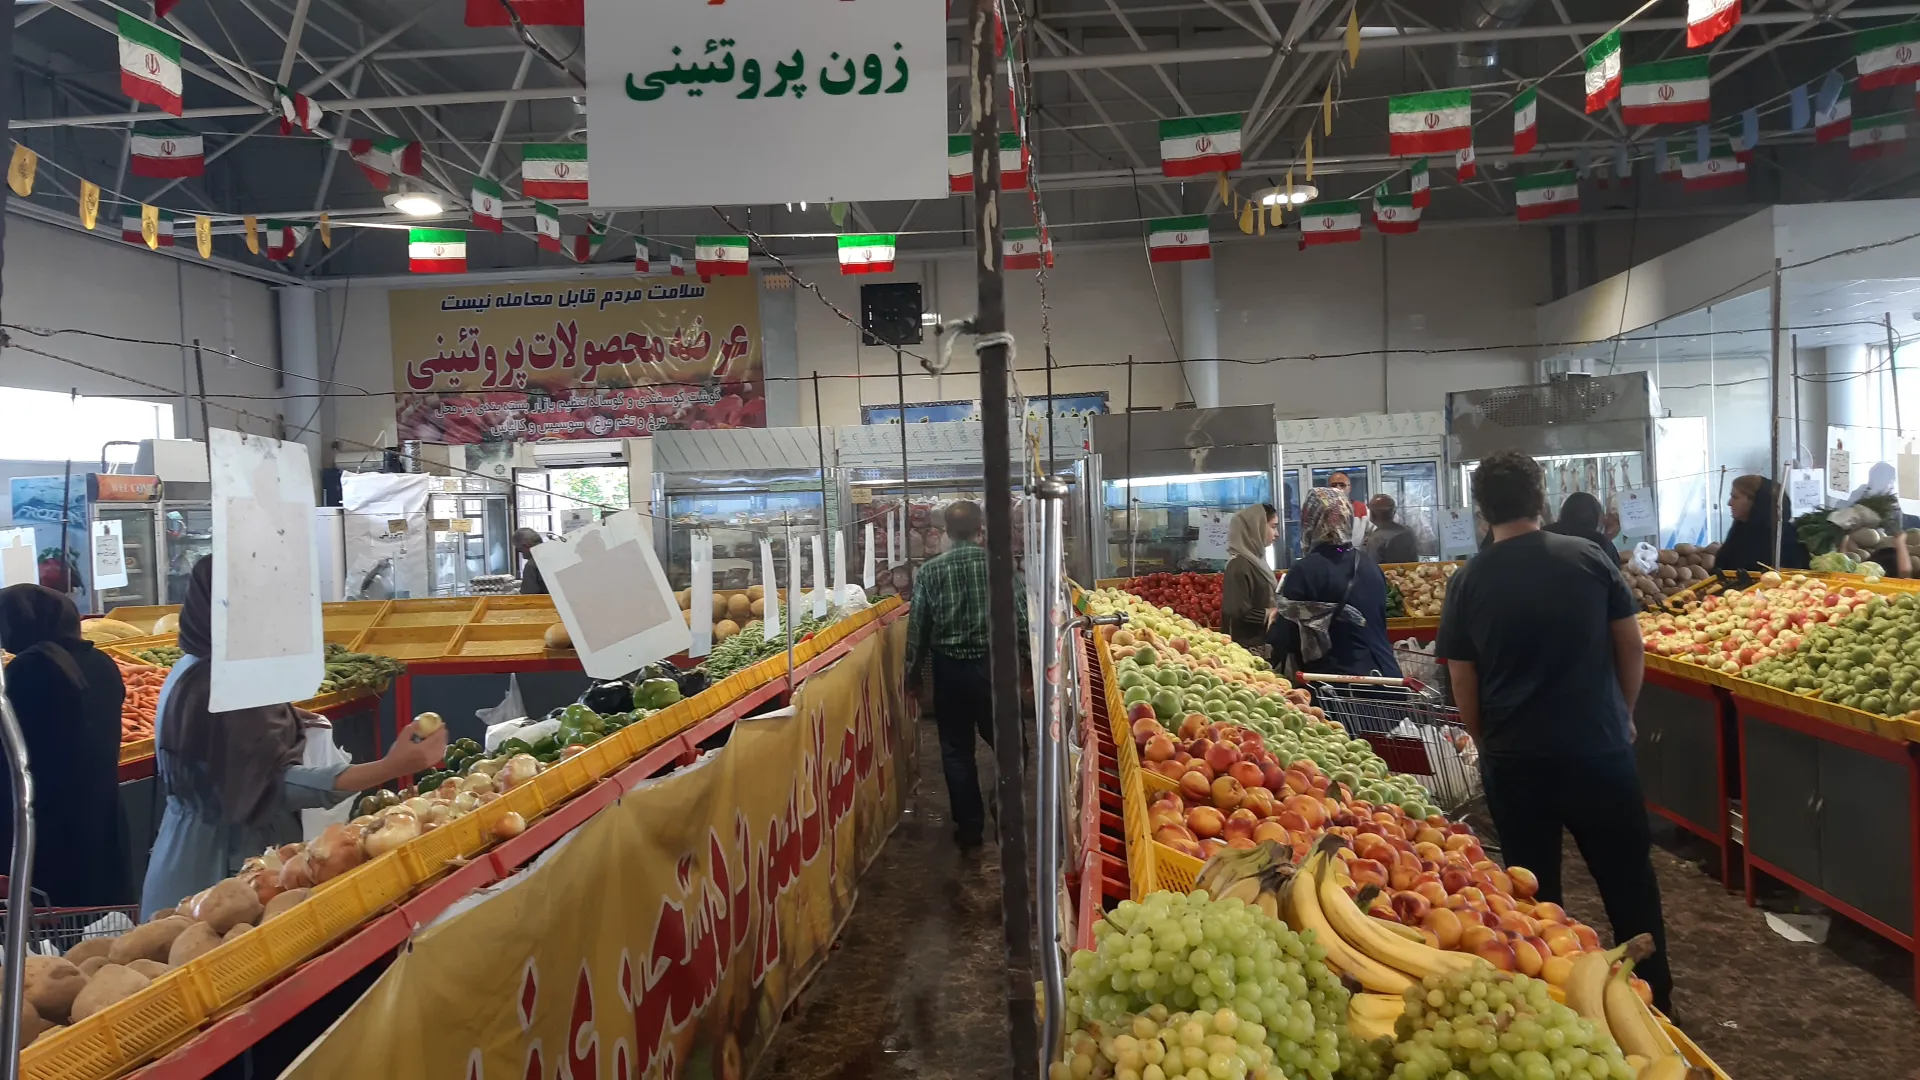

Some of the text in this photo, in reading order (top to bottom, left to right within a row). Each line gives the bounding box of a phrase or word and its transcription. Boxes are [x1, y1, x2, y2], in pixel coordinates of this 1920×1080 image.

[625, 38, 909, 102] زون پروتئینی
[440, 283, 705, 313] سلامت مردم قابل معامله نیست
[406, 315, 749, 391] عرضه محصولات پروتئینی
[434, 386, 721, 419] گوشت گوسفندی و گوساله تنظیم بازار بسته بندی در محل
[490, 418, 527, 437] کالباس
[528, 421, 537, 435] و
[536, 419, 585, 435] سوسیس
[614, 414, 637, 431] تخم
[637, 417, 645, 430] و
[646, 413, 668, 432] مرغ
